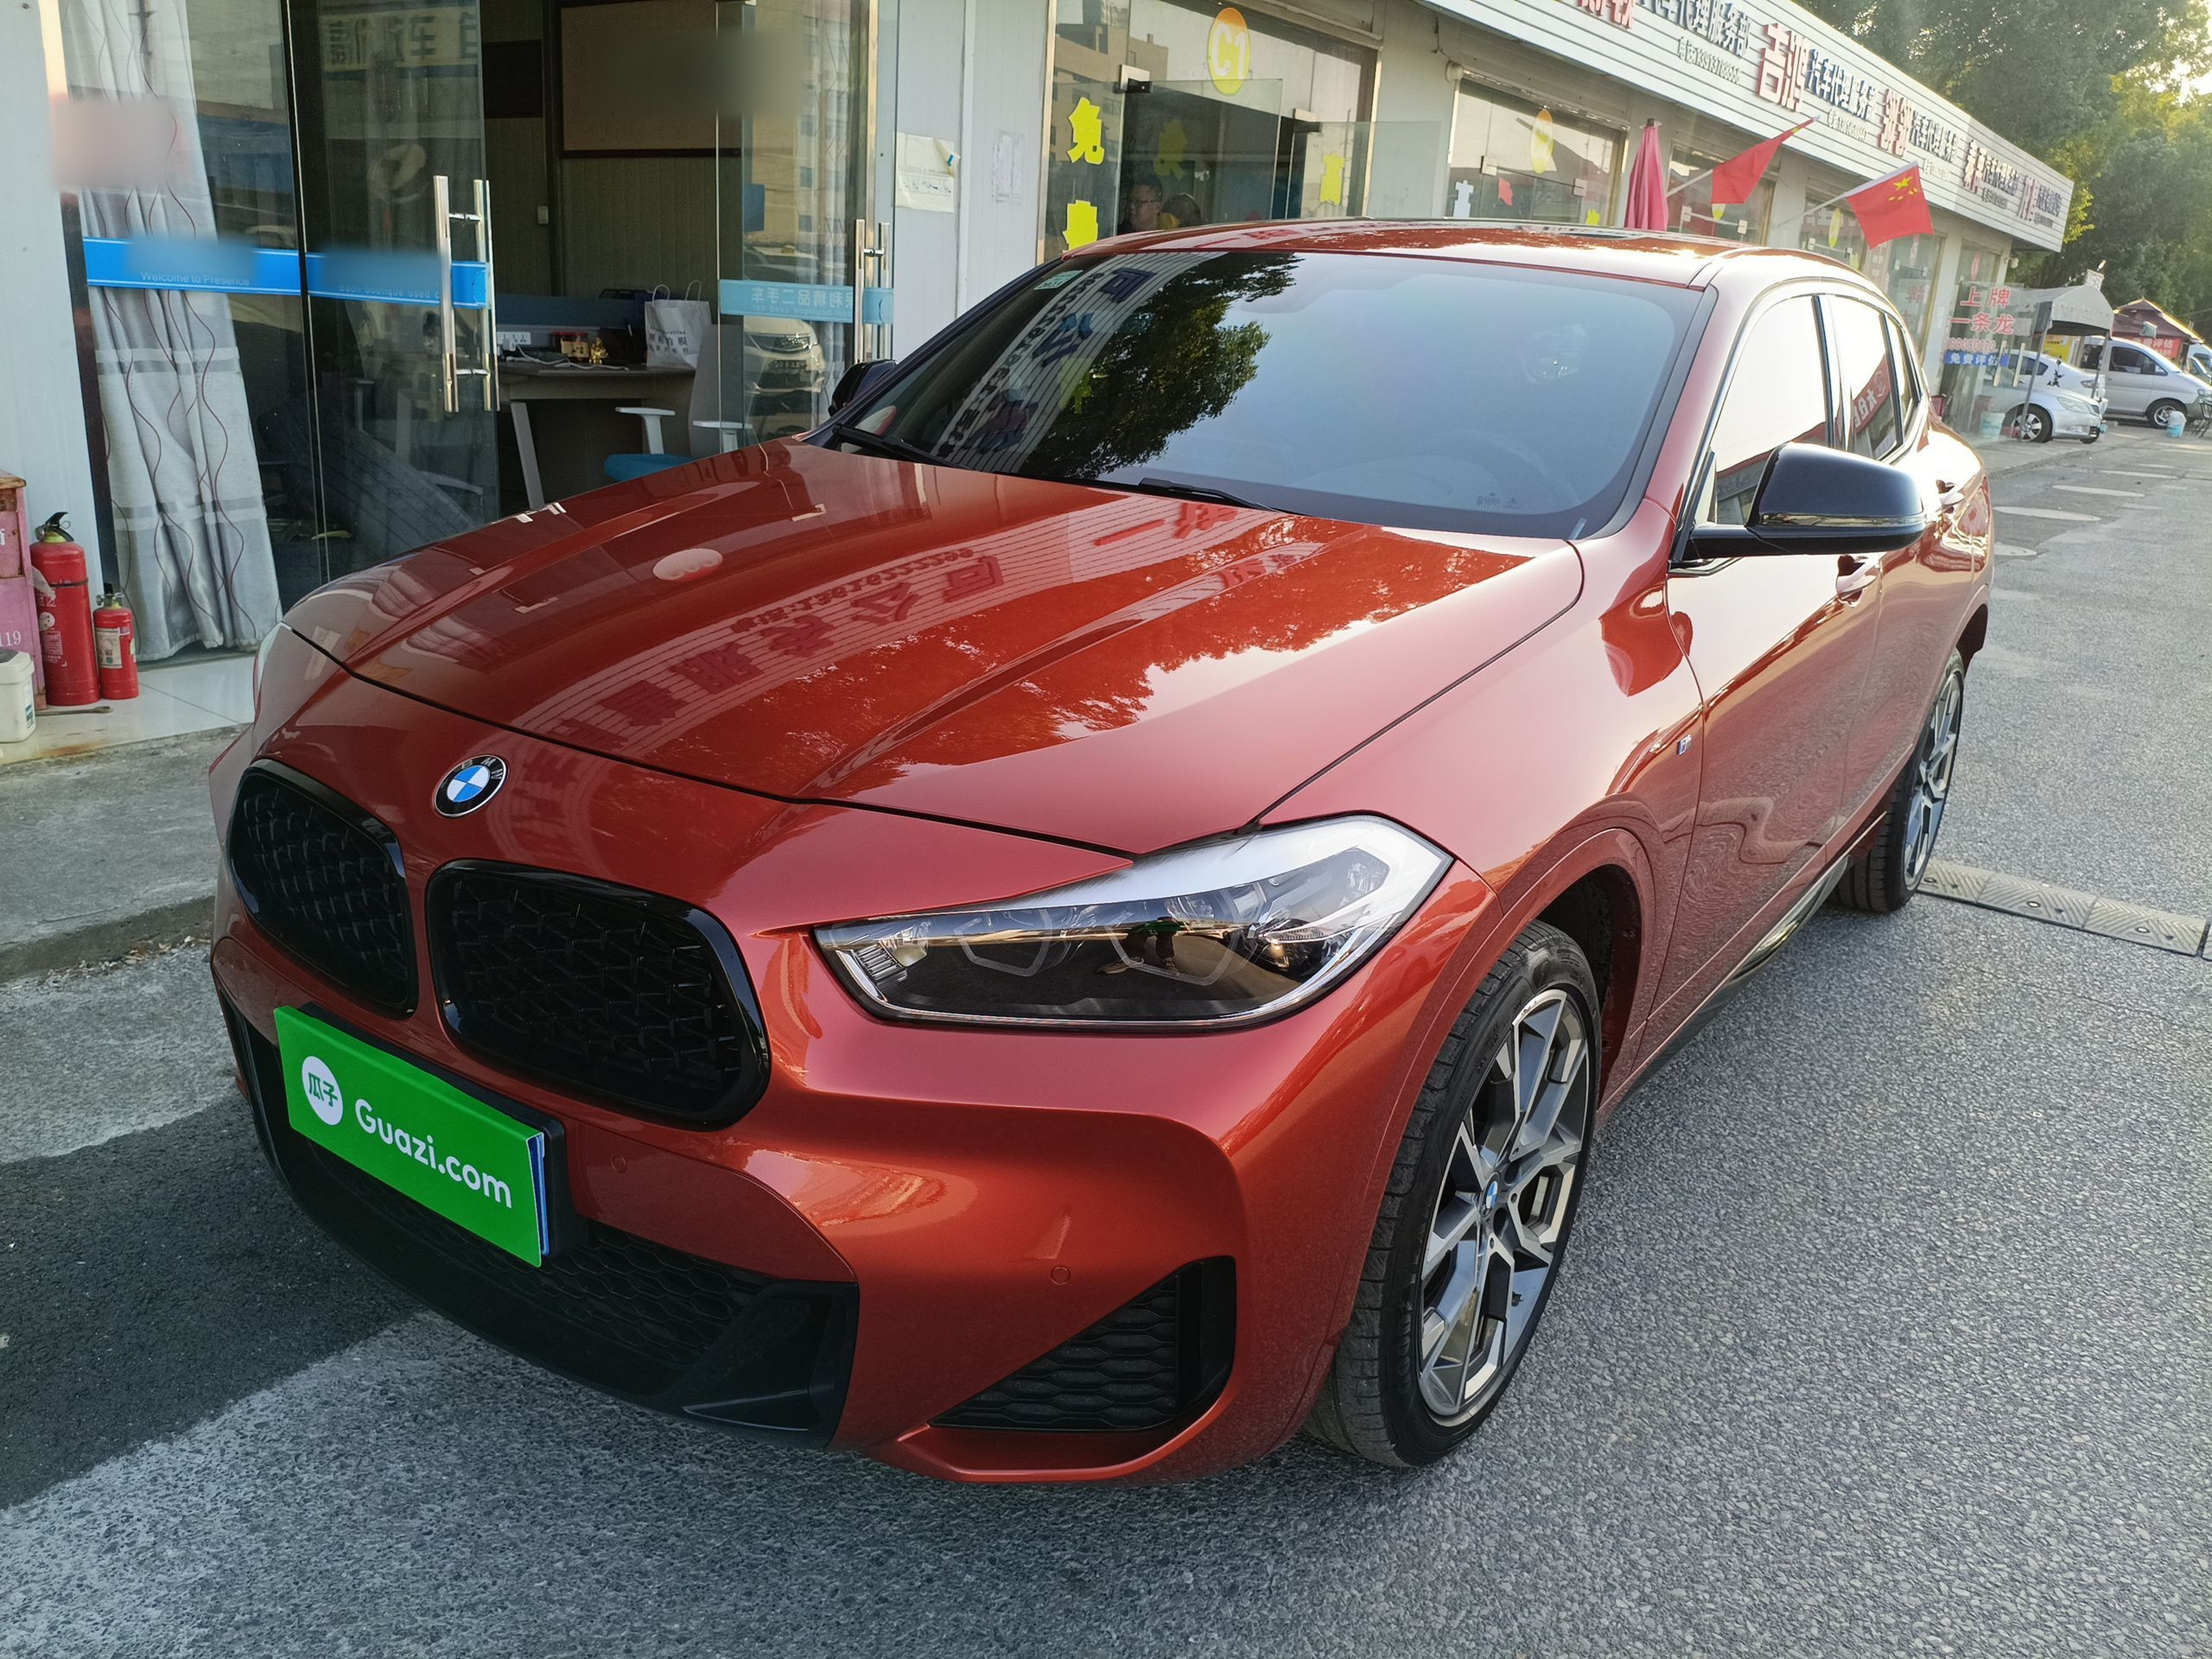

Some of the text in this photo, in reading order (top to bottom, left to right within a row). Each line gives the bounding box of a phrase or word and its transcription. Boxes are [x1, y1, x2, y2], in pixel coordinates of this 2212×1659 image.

[141, 271, 249, 286] Welcome to Presence
[1960, 286, 2011, 308] 上牌
[1949, 312, 2015, 335] 一条龙
[308, 1071, 338, 1107] 瓜子
[355, 1099, 512, 1209] Guazi.com
